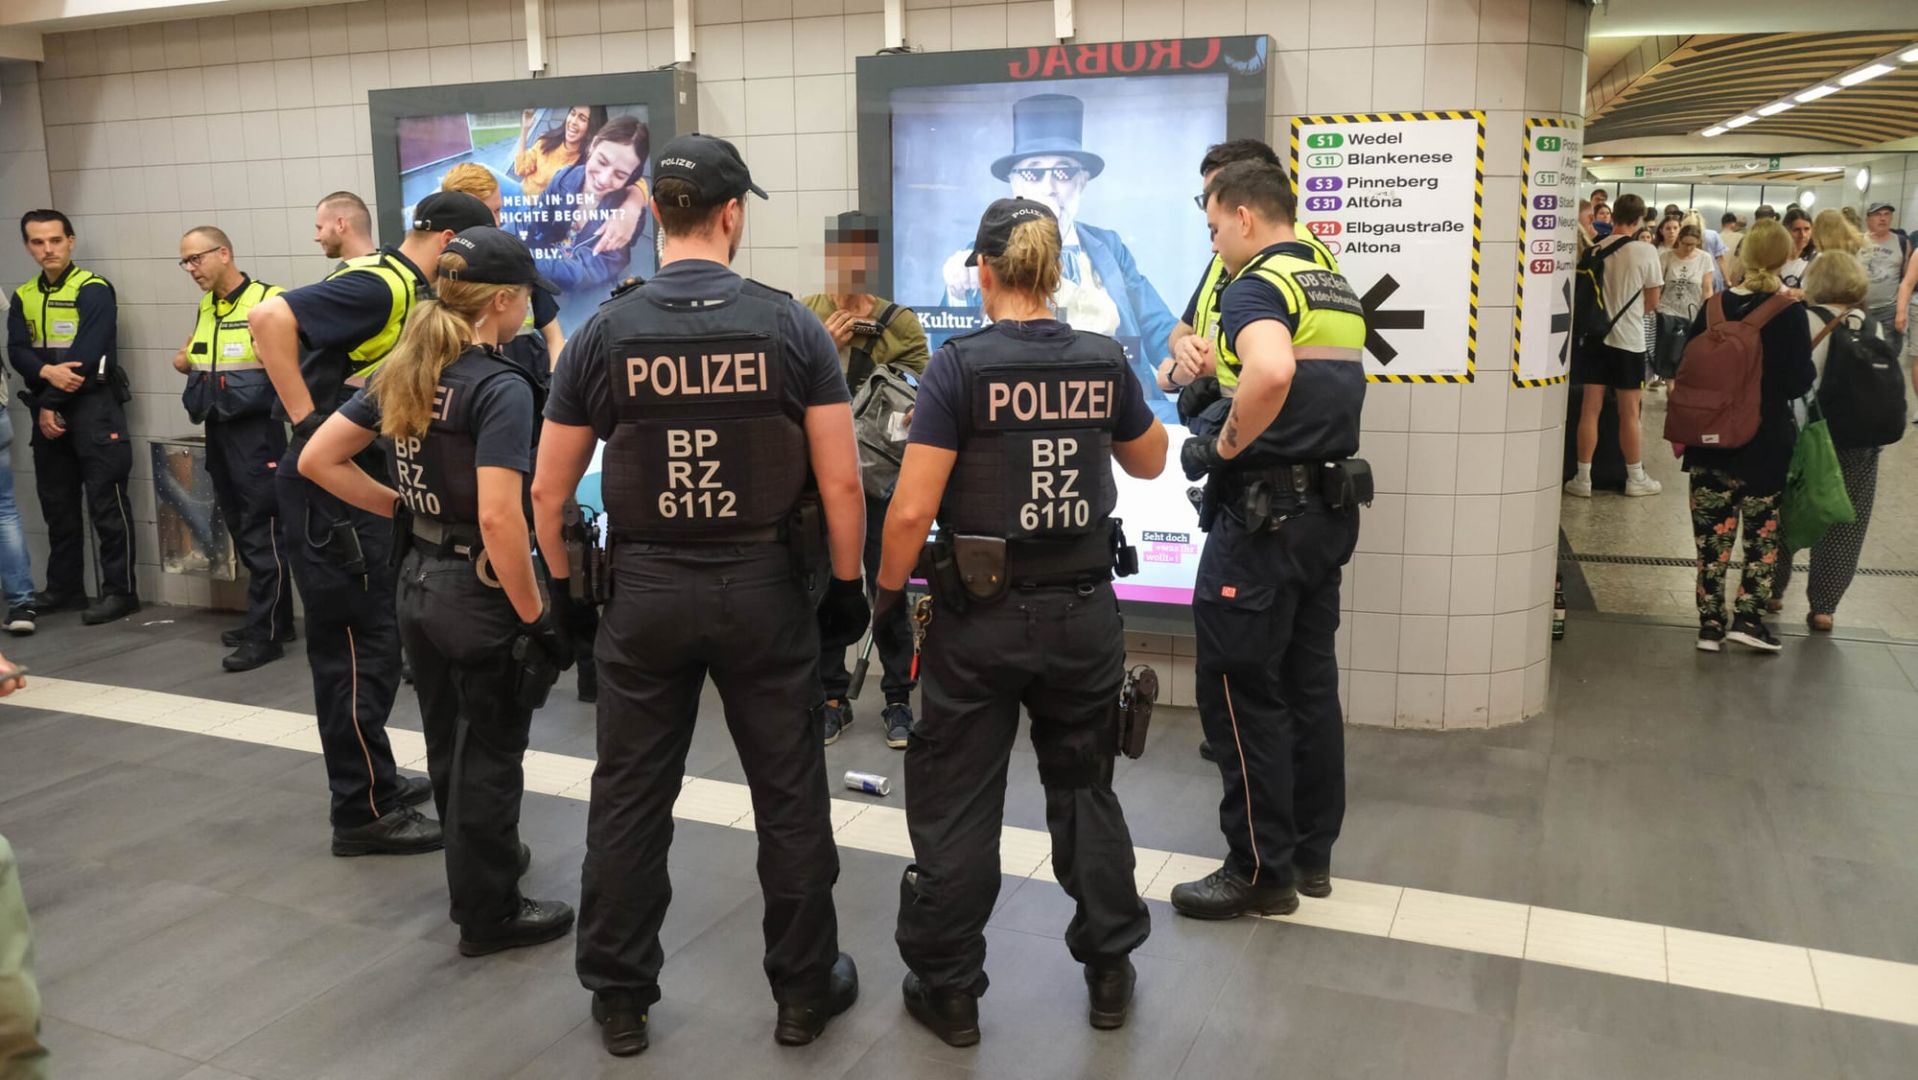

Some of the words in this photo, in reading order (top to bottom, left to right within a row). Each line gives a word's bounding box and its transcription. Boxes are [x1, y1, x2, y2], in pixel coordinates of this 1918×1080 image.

[1348, 132, 1402, 145] Wedel
[661, 157, 696, 170] POLIZEI
[1347, 152, 1453, 165] Blankenese
[1346, 176, 1438, 190] Pinneberg
[503, 195, 543, 208] MENT,
[546, 194, 560, 205] IN
[566, 193, 595, 205] DEM
[1346, 197, 1402, 209] Altona
[500, 210, 549, 223] HICHTE
[554, 209, 626, 222] BEGINNT?
[1011, 208, 1045, 219] POLIZ
[1346, 220, 1465, 236] Elbgaustraße
[1345, 242, 1401, 253] Altona
[1295, 273, 1319, 288] DB
[917, 311, 994, 328] Kultur-A
[626, 352, 767, 397] POLIZEI
[989, 381, 1113, 422] POLIZEI
[394, 435, 421, 460] BP
[667, 429, 718, 457] BP
[1032, 438, 1078, 467] BP
[397, 459, 427, 489] RZ
[668, 460, 723, 489] RZ
[1031, 469, 1079, 500] RZ
[658, 491, 737, 518] 6112
[1020, 499, 1089, 531] 6110
[1144, 532, 1164, 541] Seht
[1165, 533, 1188, 543] doch
